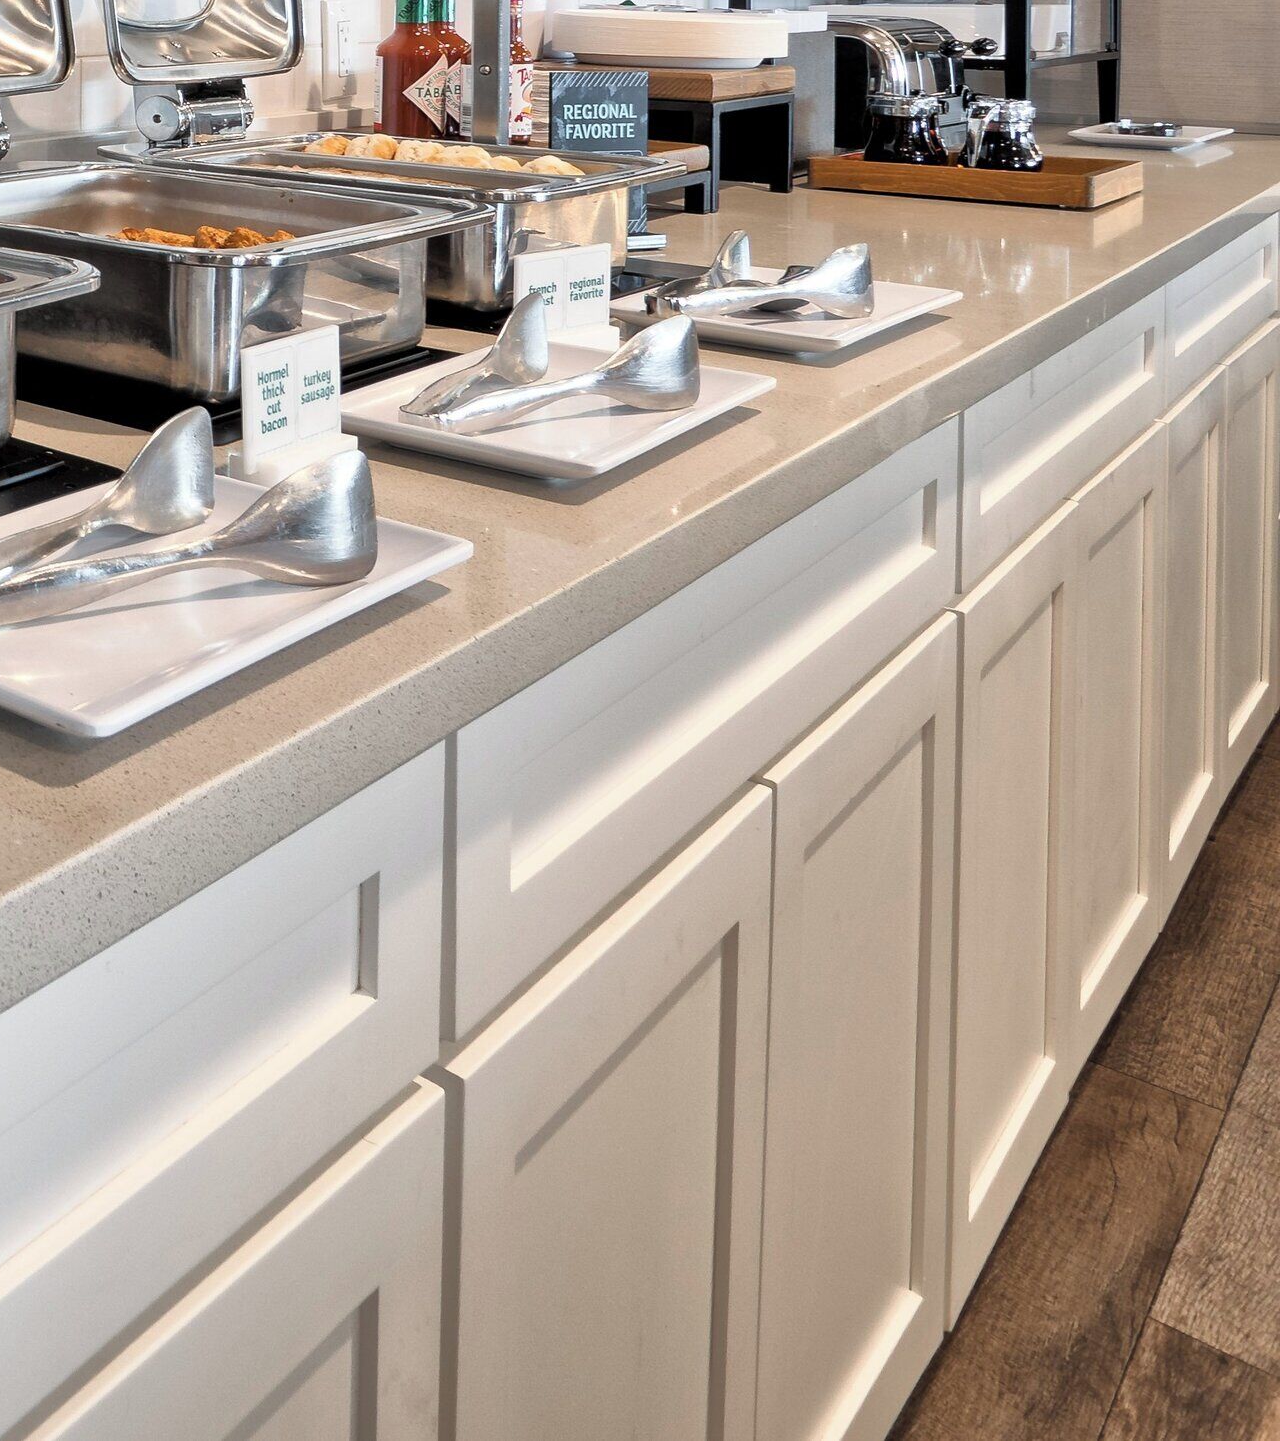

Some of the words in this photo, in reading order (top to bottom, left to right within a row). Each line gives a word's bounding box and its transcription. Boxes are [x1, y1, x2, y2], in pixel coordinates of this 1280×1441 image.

[563, 103, 638, 121] REGIONAL
[565, 122, 635, 140] FAVORITE
[529, 282, 557, 295] french
[569, 274, 605, 292] regional
[570, 287, 604, 302] favorite
[257, 363, 289, 386] Hormel
[303, 369, 332, 388] turkey
[262, 382, 286, 401] thick
[300, 384, 335, 405] sausage
[266, 400, 282, 416] cut
[260, 416, 288, 435] bacon
